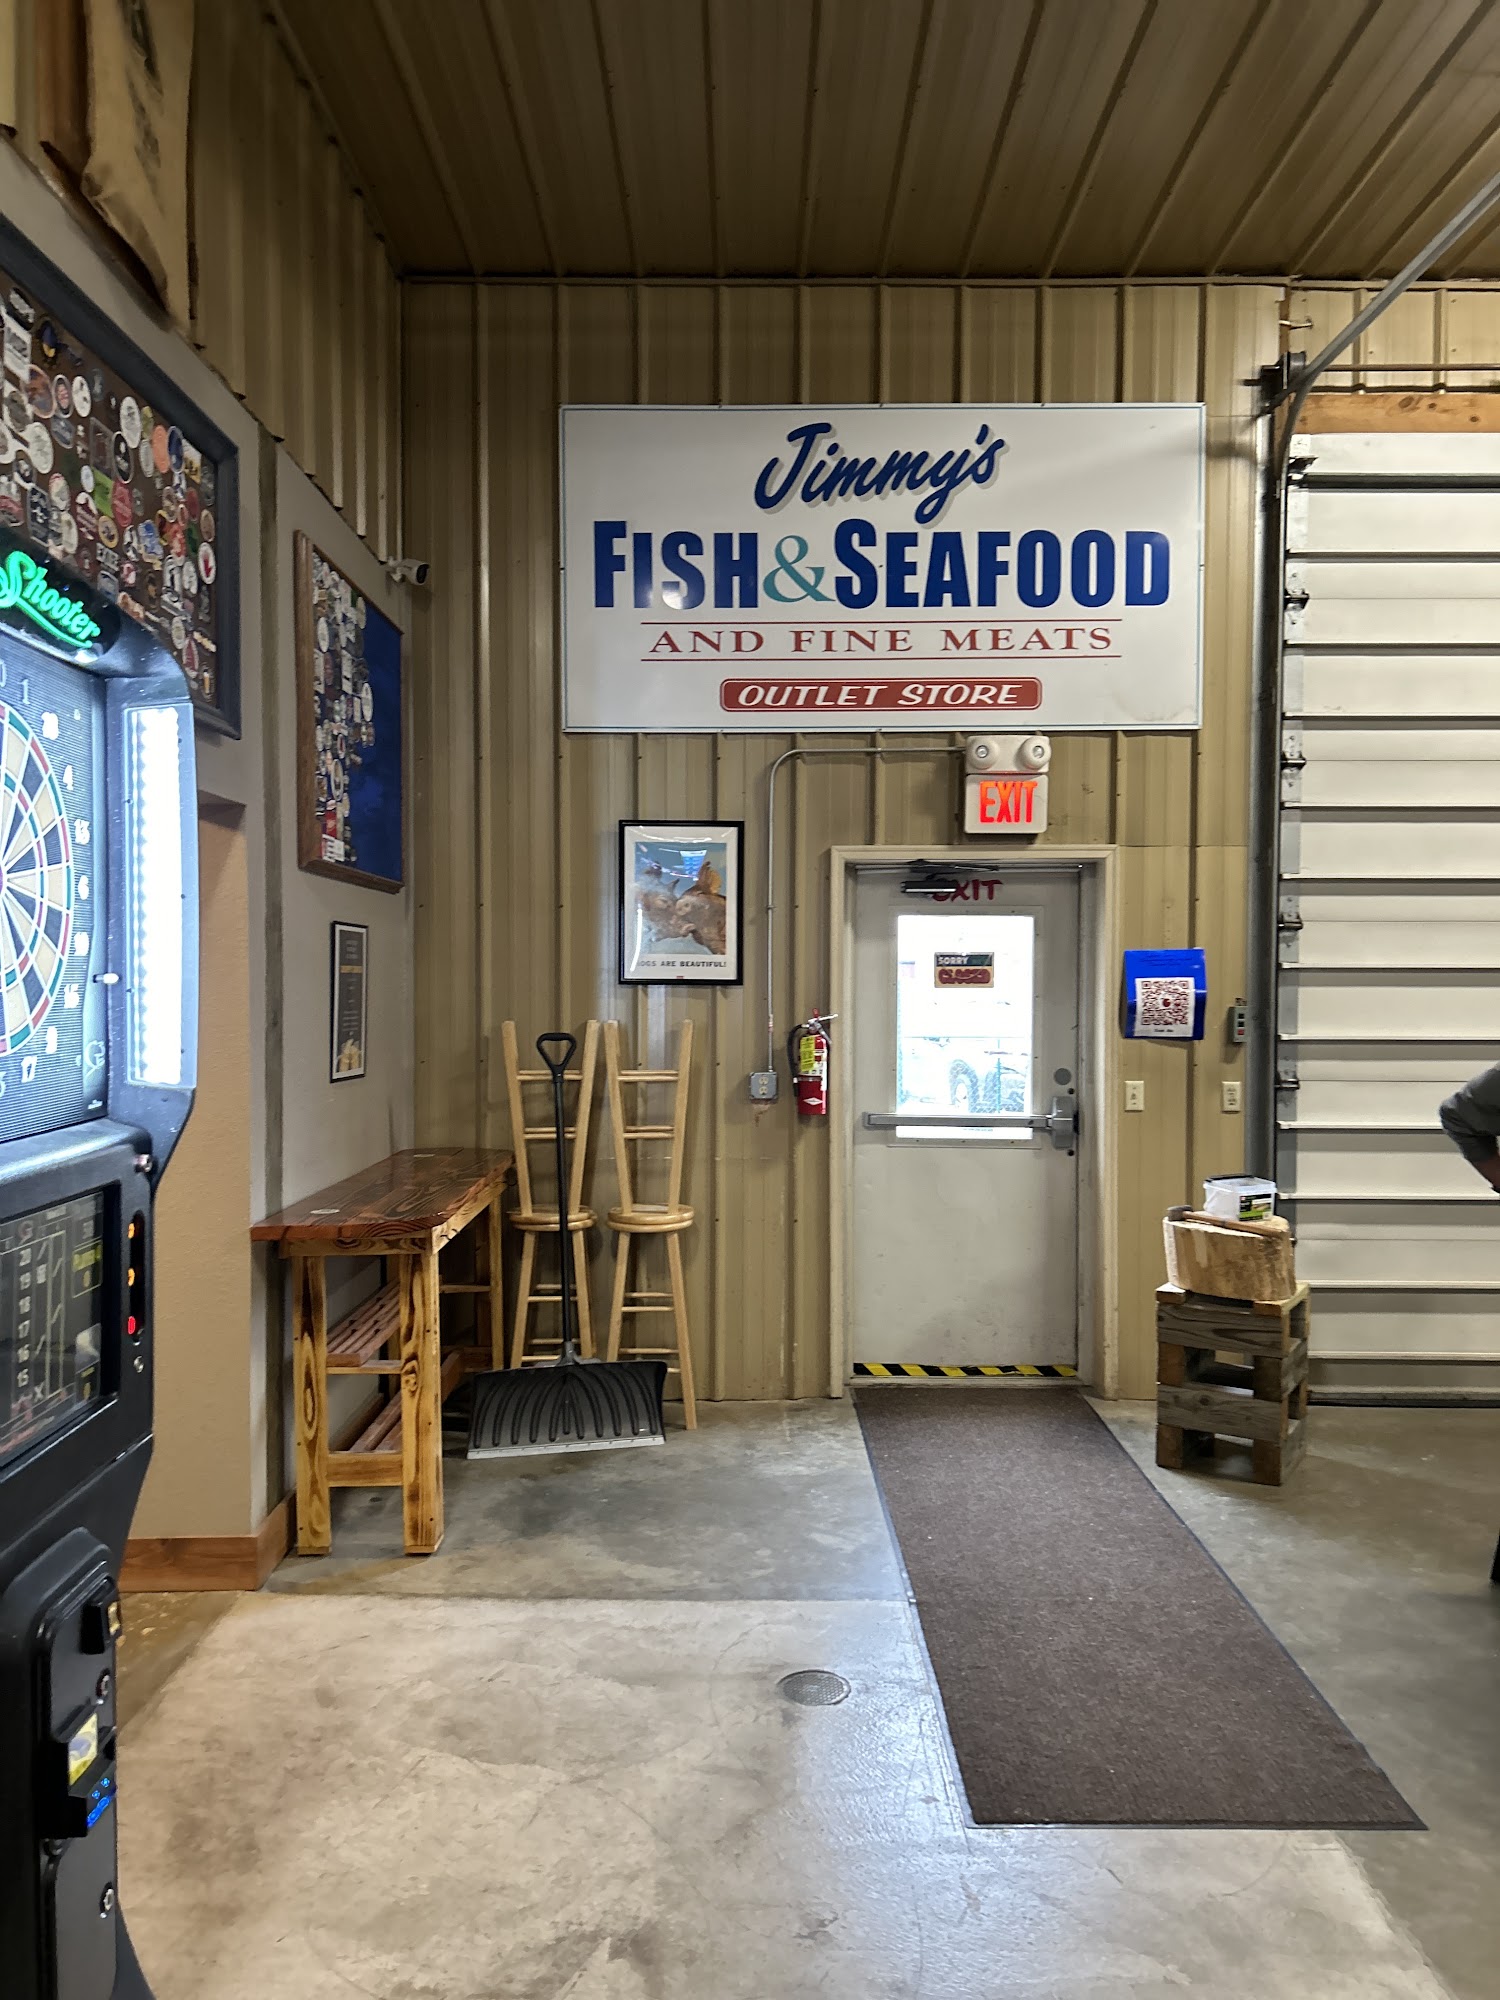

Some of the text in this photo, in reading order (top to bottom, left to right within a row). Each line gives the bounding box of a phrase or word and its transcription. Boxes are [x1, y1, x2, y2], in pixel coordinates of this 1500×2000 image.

[753, 421, 1007, 526] Jimmy's
[834, 518, 1171, 609] SEAFOOD
[648, 626, 1114, 654] AND FINE MEATS
[737, 683, 1023, 708] OUTLET STORE
[979, 781, 1037, 823] EXIT
[938, 956, 969, 965] SORRY
